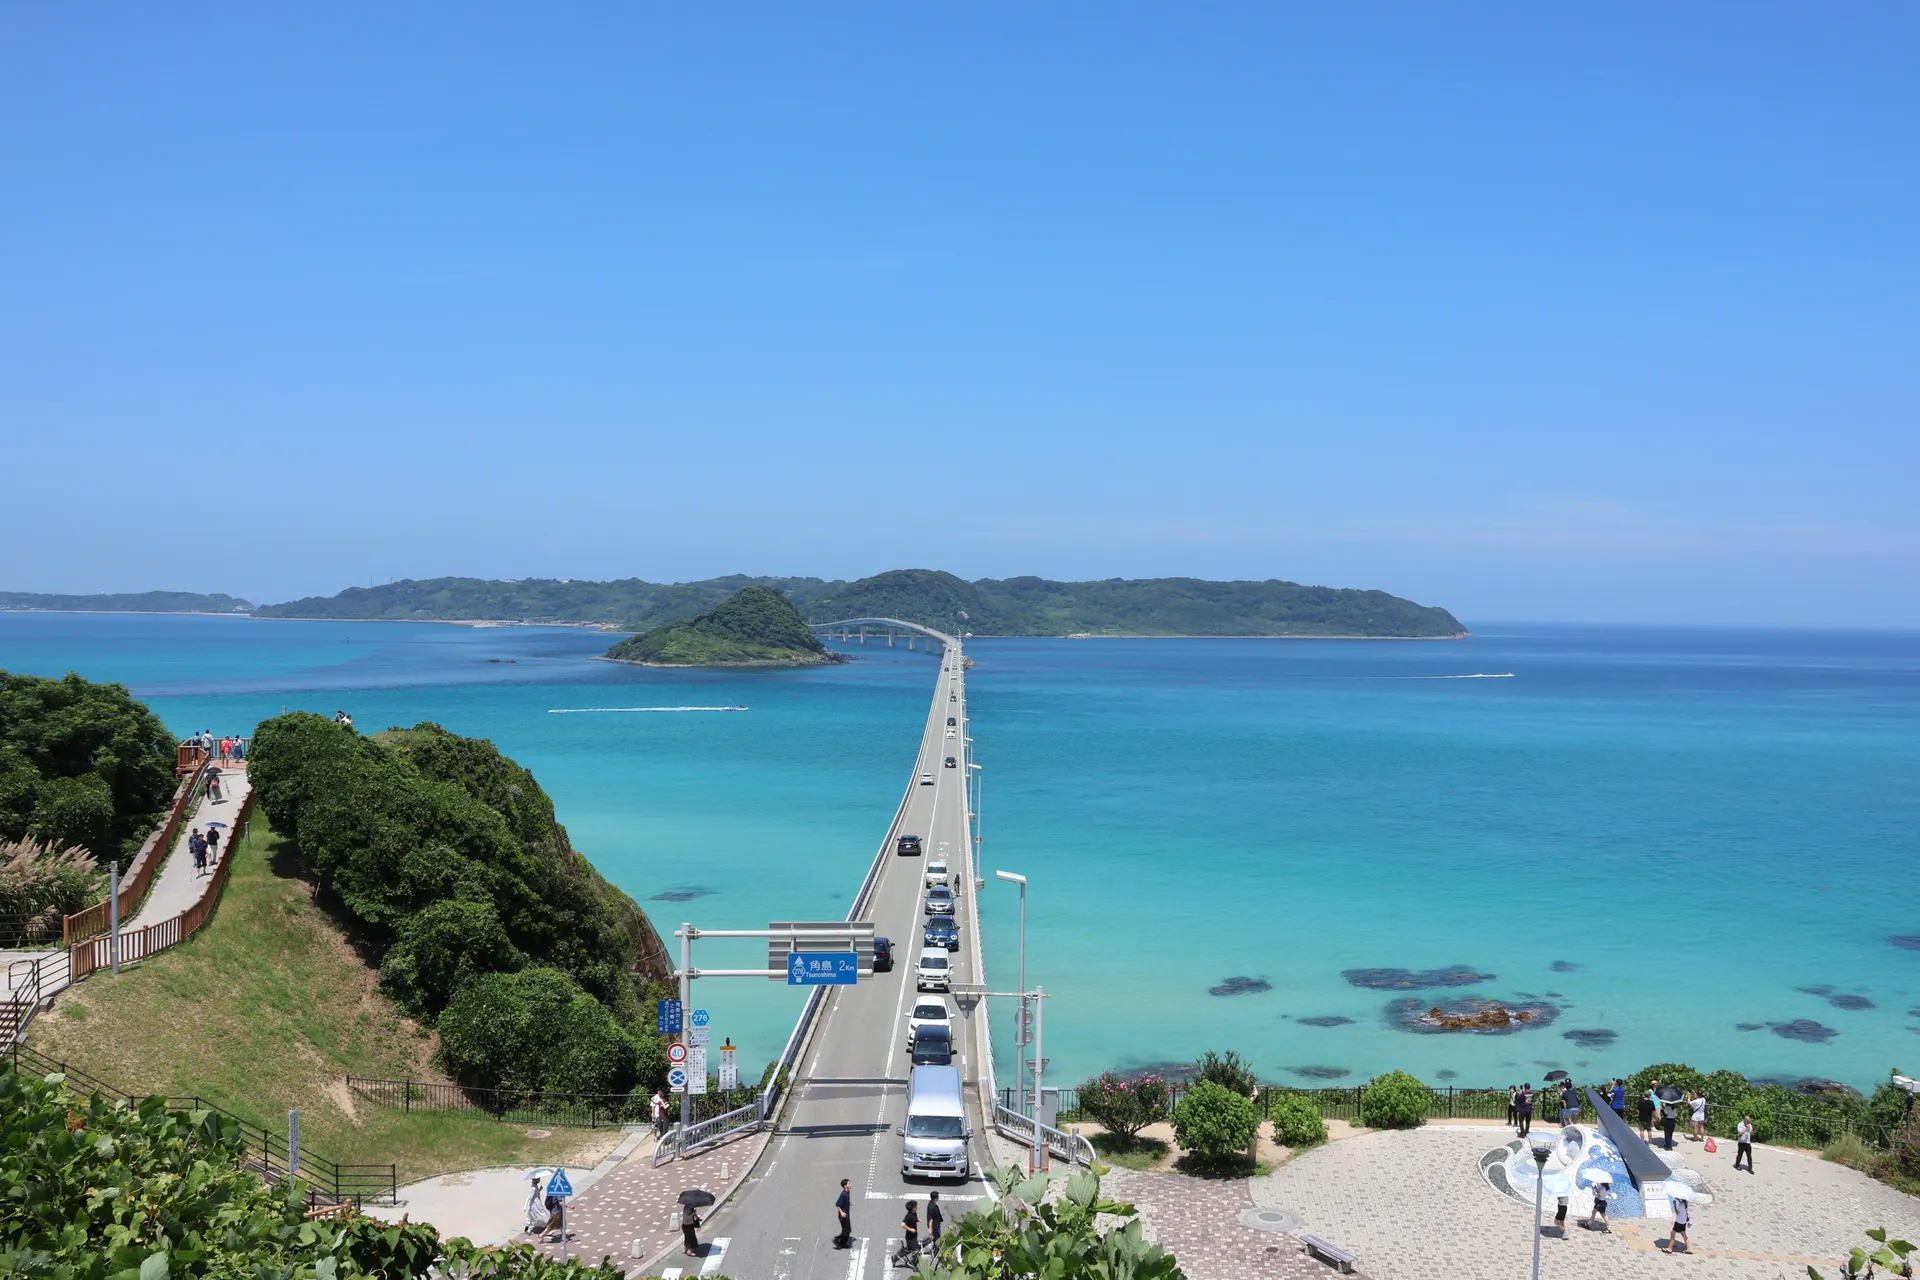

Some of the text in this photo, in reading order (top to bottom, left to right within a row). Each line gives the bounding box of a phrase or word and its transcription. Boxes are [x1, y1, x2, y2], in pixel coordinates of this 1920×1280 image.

[810, 960, 832, 971] 角島
[693, 1014, 708, 1022] 276
[671, 1048, 683, 1058] 40
